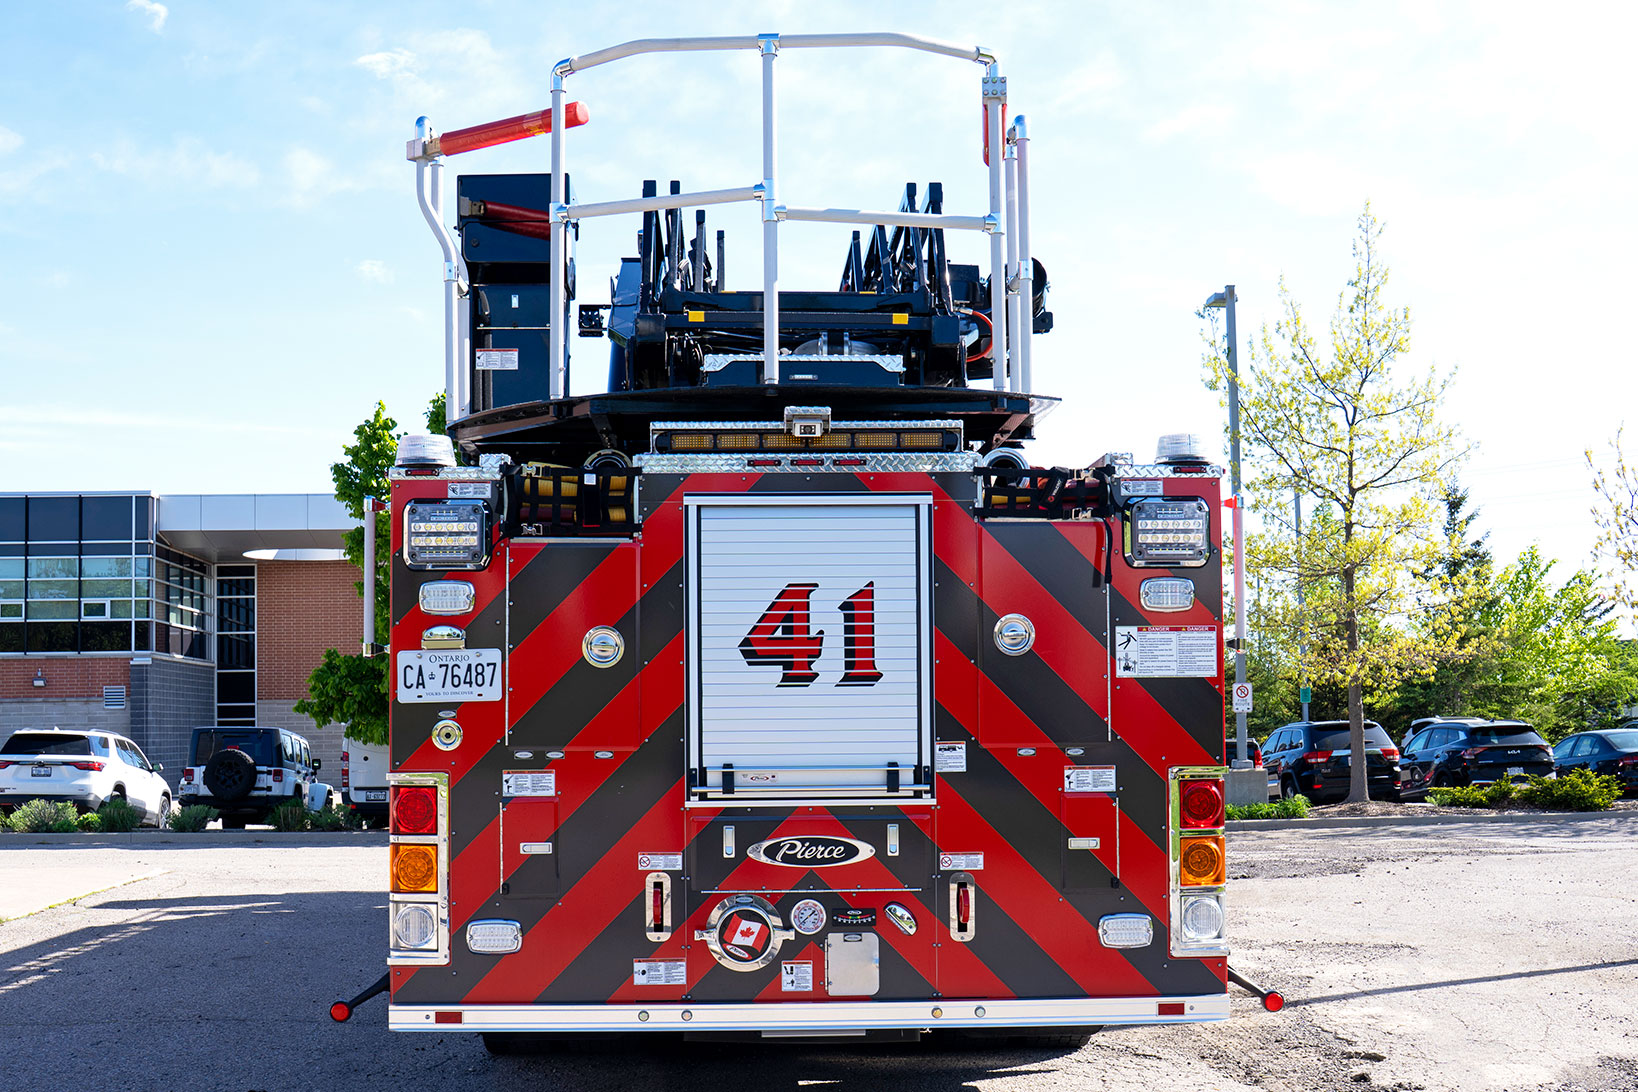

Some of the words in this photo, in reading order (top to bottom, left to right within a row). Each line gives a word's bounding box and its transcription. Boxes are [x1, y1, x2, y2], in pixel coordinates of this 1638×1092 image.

[737, 580, 884, 688] 41
[403, 664, 426, 689] CA
[439, 662, 497, 689] 76487
[775, 839, 846, 862] Pierce
